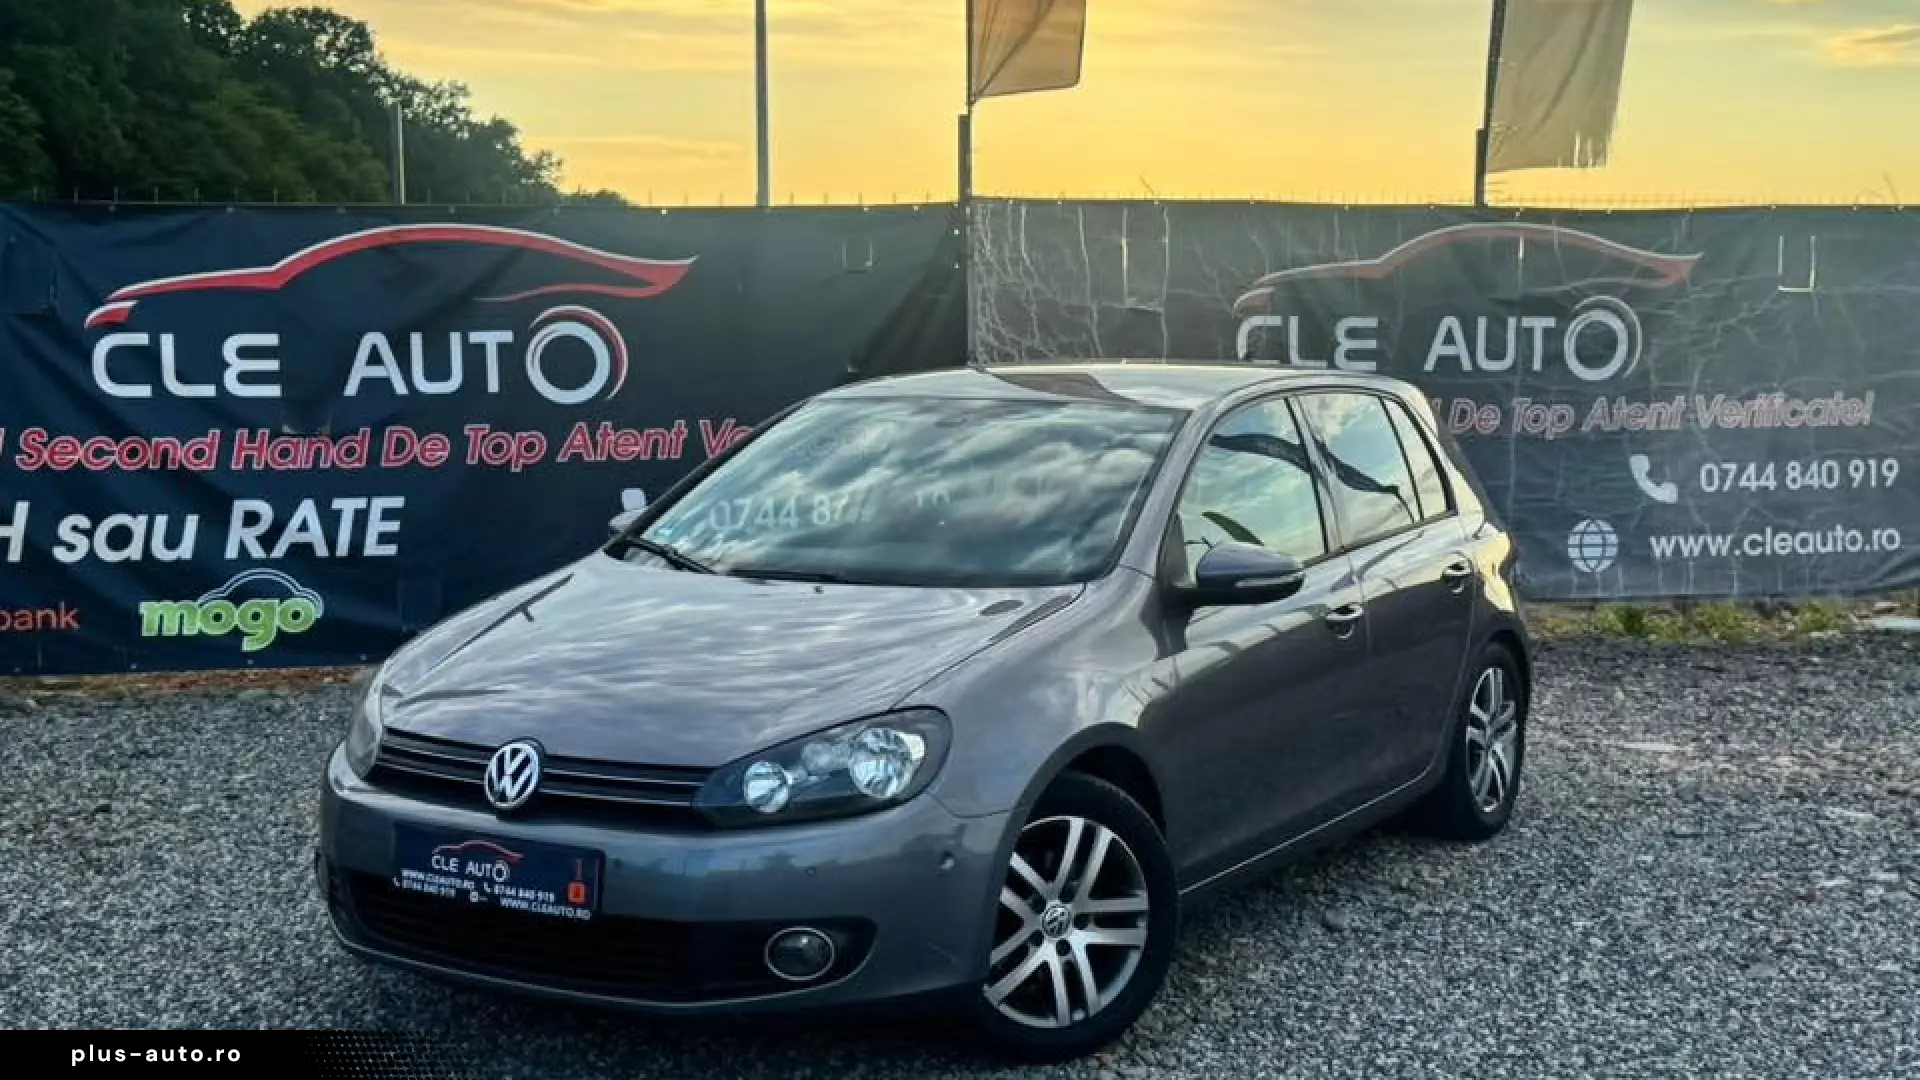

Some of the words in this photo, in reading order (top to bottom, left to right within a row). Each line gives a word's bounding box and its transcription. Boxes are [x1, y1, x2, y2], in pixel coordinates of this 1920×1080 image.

[92, 332, 282, 398] CLE
[343, 318, 614, 404] AUTO
[1236, 315, 1379, 371] CLE
[1423, 308, 1630, 381] AUTO
[1449, 400, 1501, 434] De
[1512, 398, 1573, 440] Top
[1582, 395, 1686, 431] Atent
[1695, 390, 1875, 429] Verificate!
[15, 427, 220, 471] Second
[231, 425, 370, 470] Hand
[381, 424, 450, 468] De
[464, 423, 544, 472] Top
[556, 419, 688, 462] Atent
[1701, 462, 1776, 493] 0744
[1786, 459, 1840, 490] 840
[1848, 457, 1899, 488] 919
[51, 512, 199, 563] sau
[225, 496, 406, 560] RATE
[1650, 524, 1900, 558] www.cleauto.ro
[139, 599, 319, 651] mogo
[431, 856, 459, 873] CLE
[465, 861, 510, 882] AUTO
